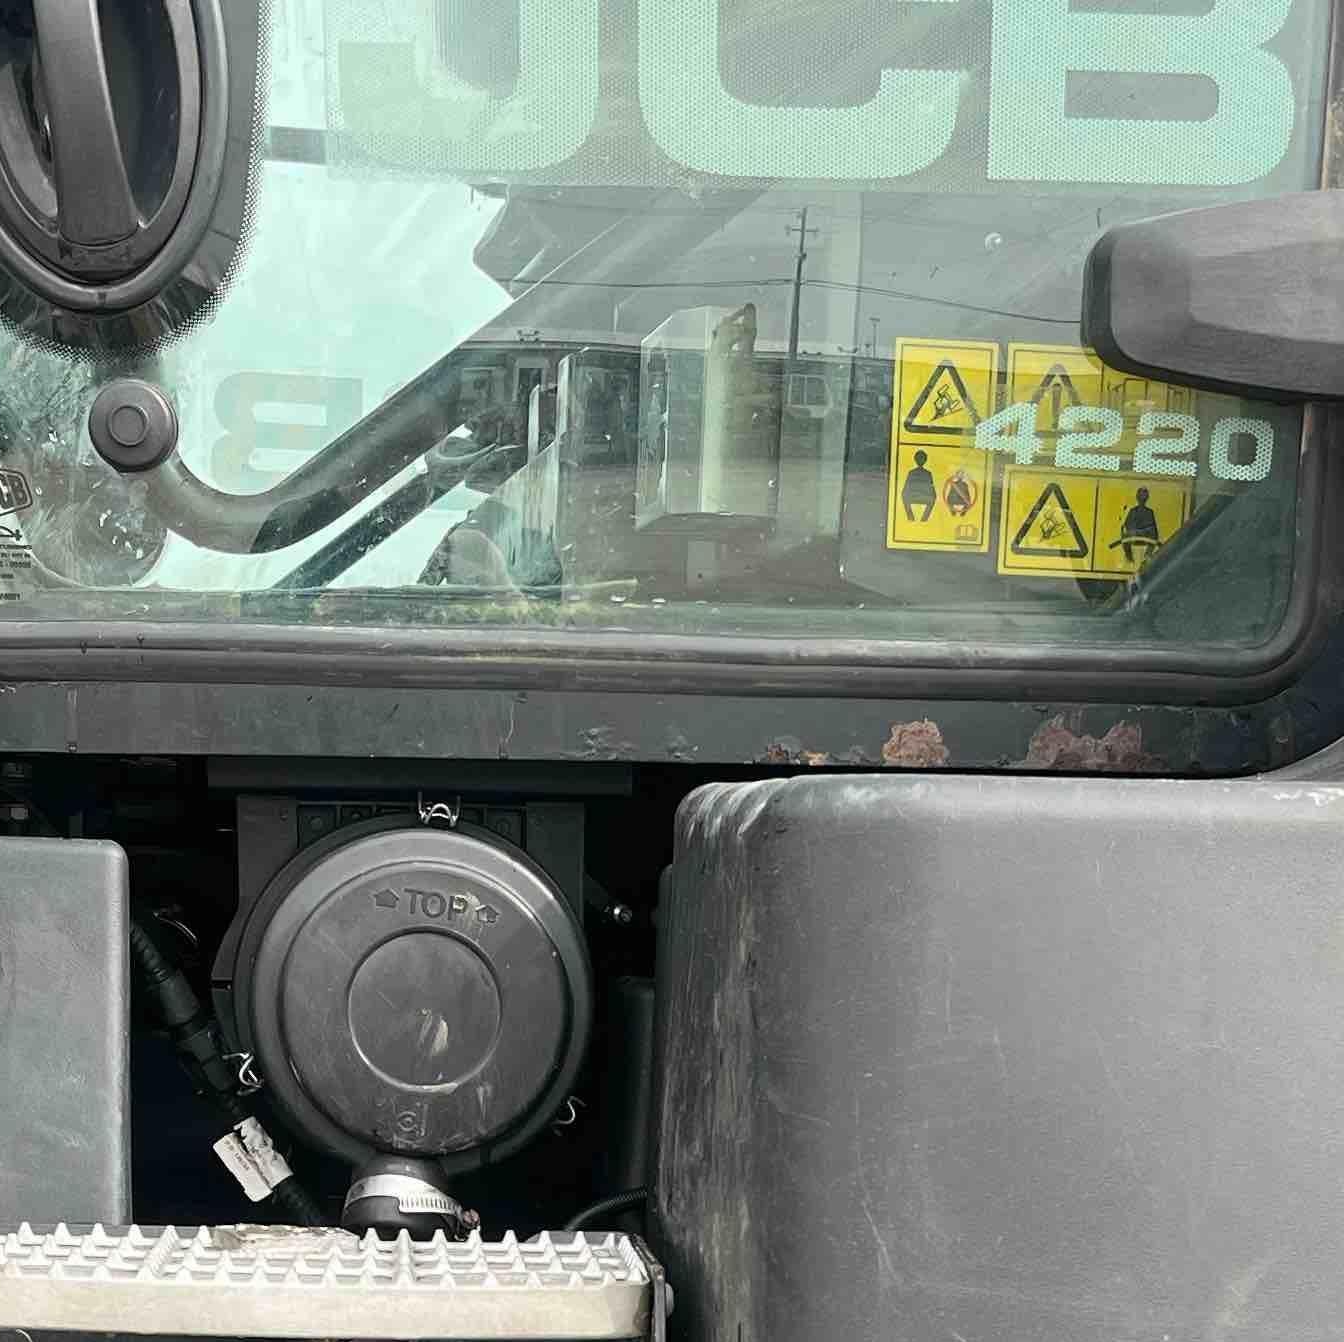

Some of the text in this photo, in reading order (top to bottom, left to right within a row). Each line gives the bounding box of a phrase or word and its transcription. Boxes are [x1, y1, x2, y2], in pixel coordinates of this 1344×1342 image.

[339, 0, 1296, 186] JCB
[975, 402, 1275, 482] 4220
[403, 886, 469, 921] TOP
